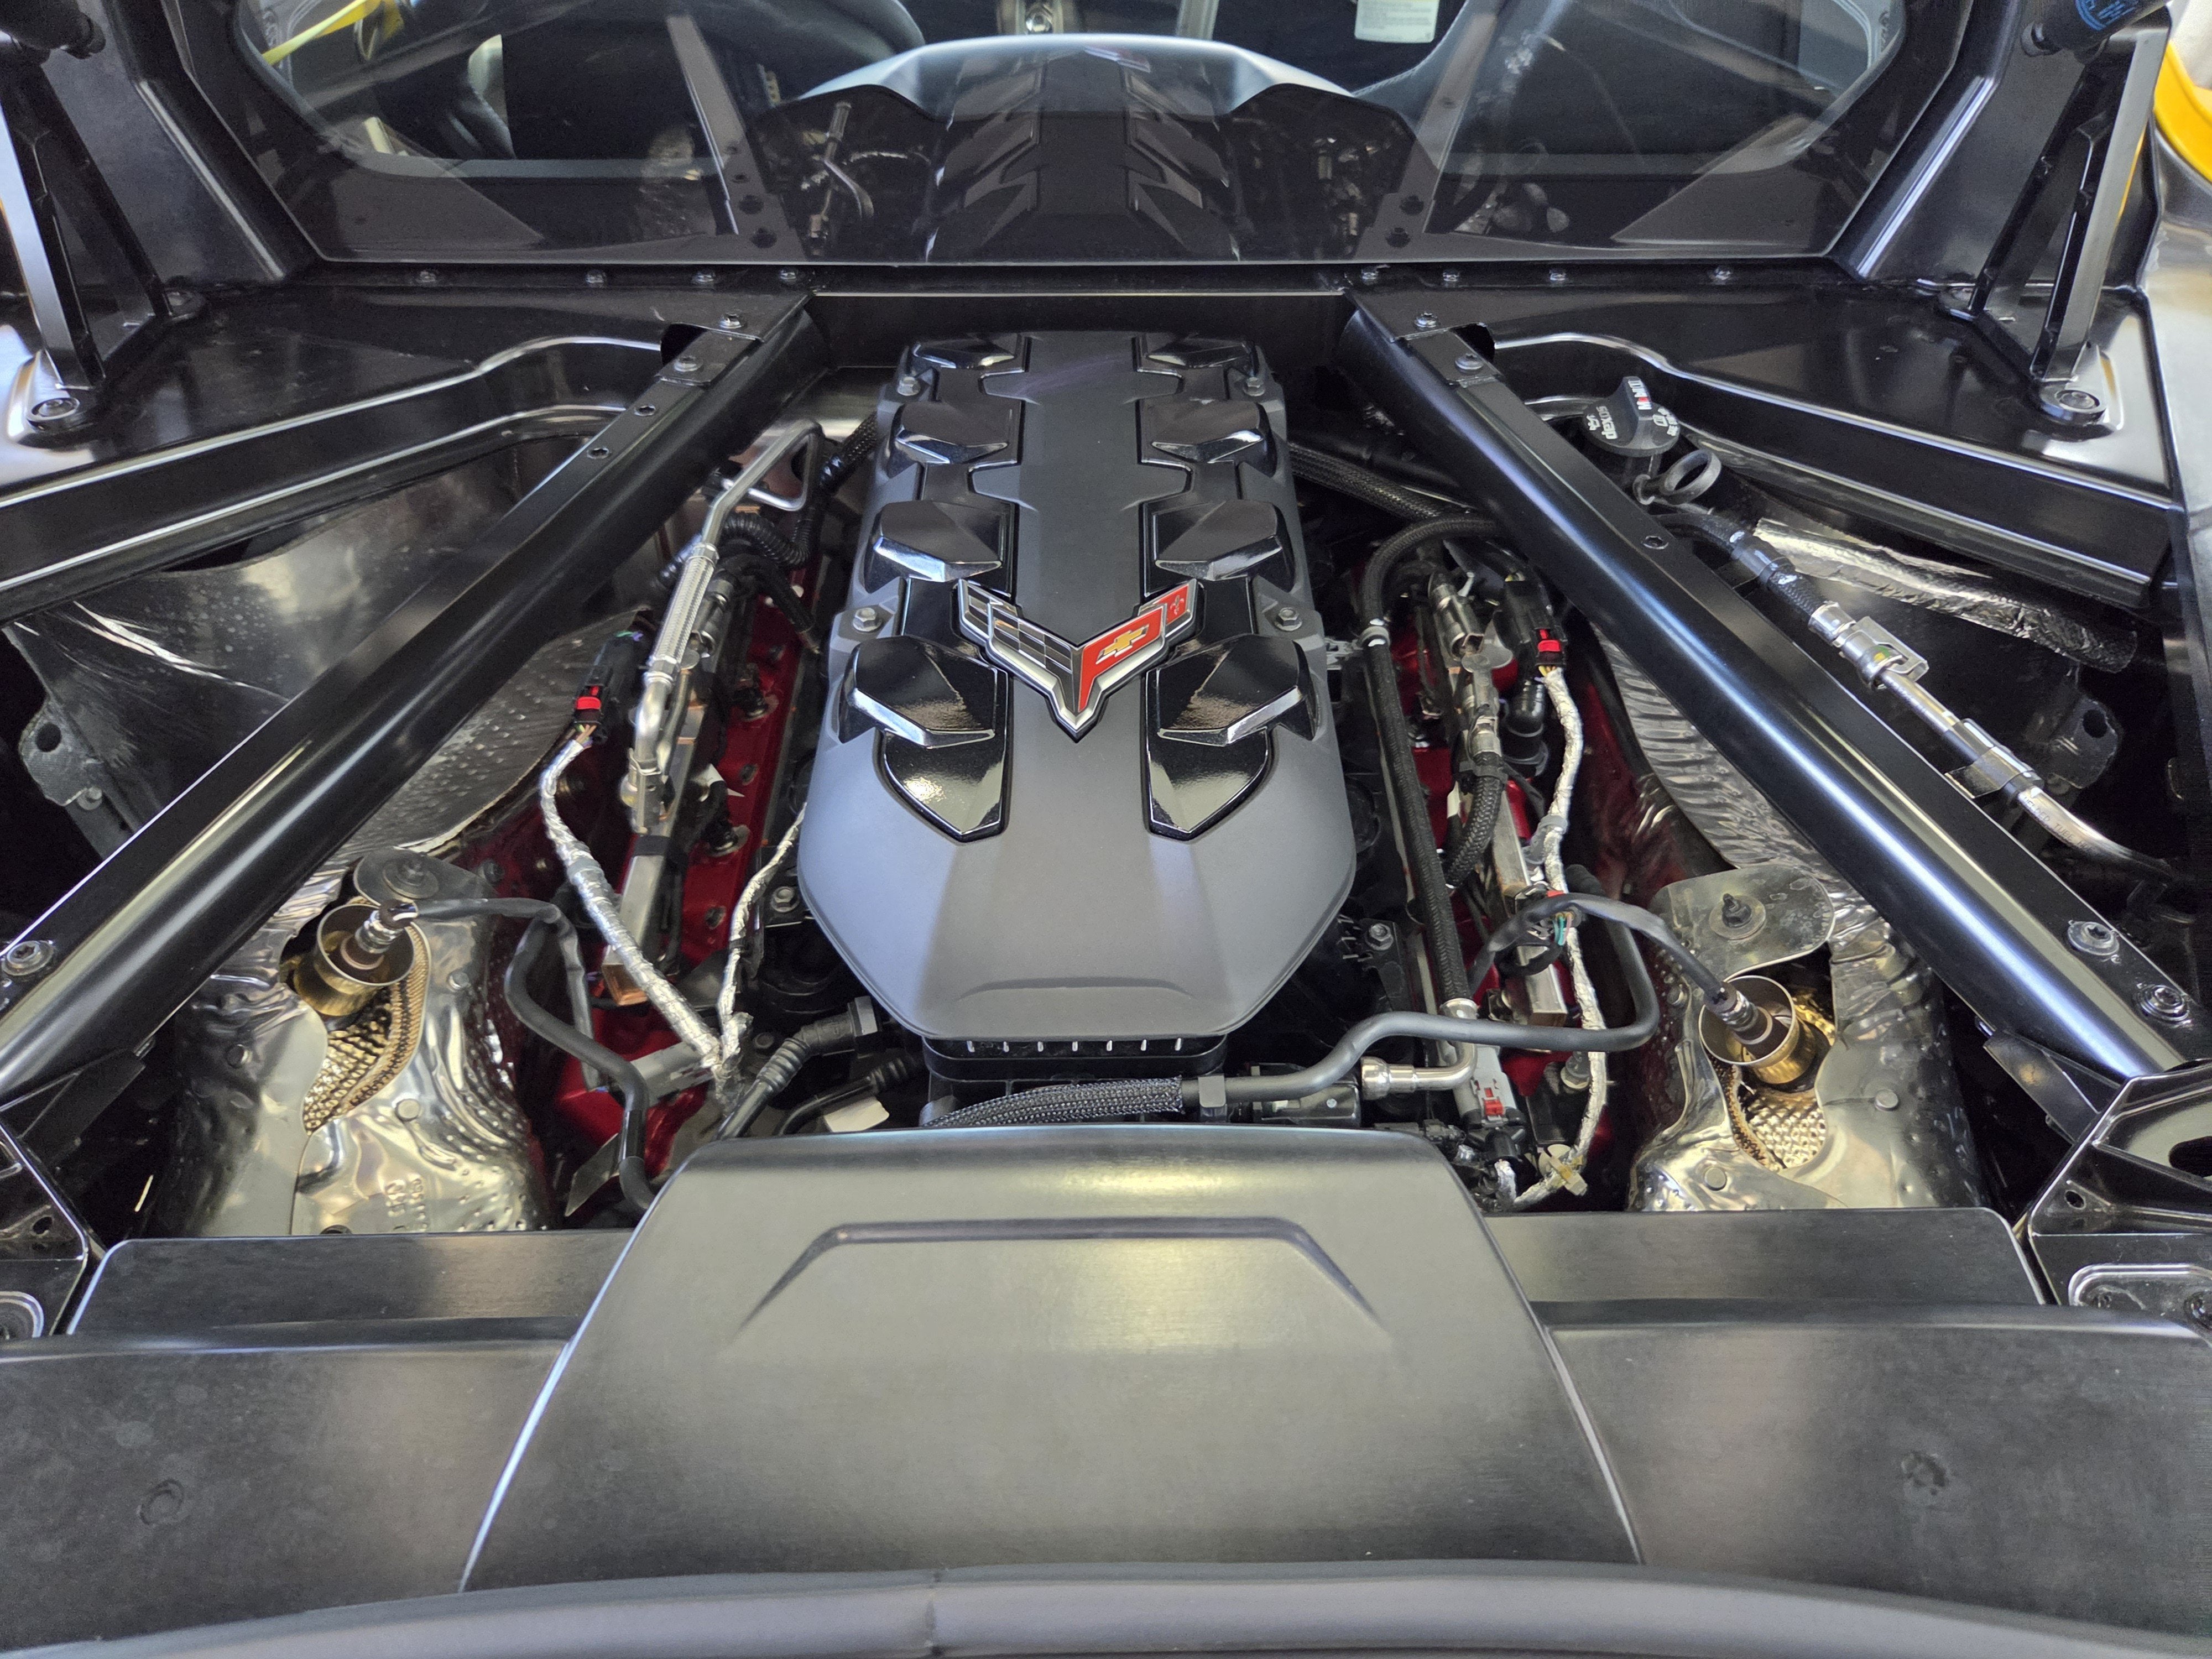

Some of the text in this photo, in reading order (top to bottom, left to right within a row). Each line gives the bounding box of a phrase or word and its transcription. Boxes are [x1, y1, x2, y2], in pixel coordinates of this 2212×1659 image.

[1632, 388, 1652, 410] Mobil
[1595, 405, 1618, 440] dexos
[2054, 823, 2075, 842] TUBE
